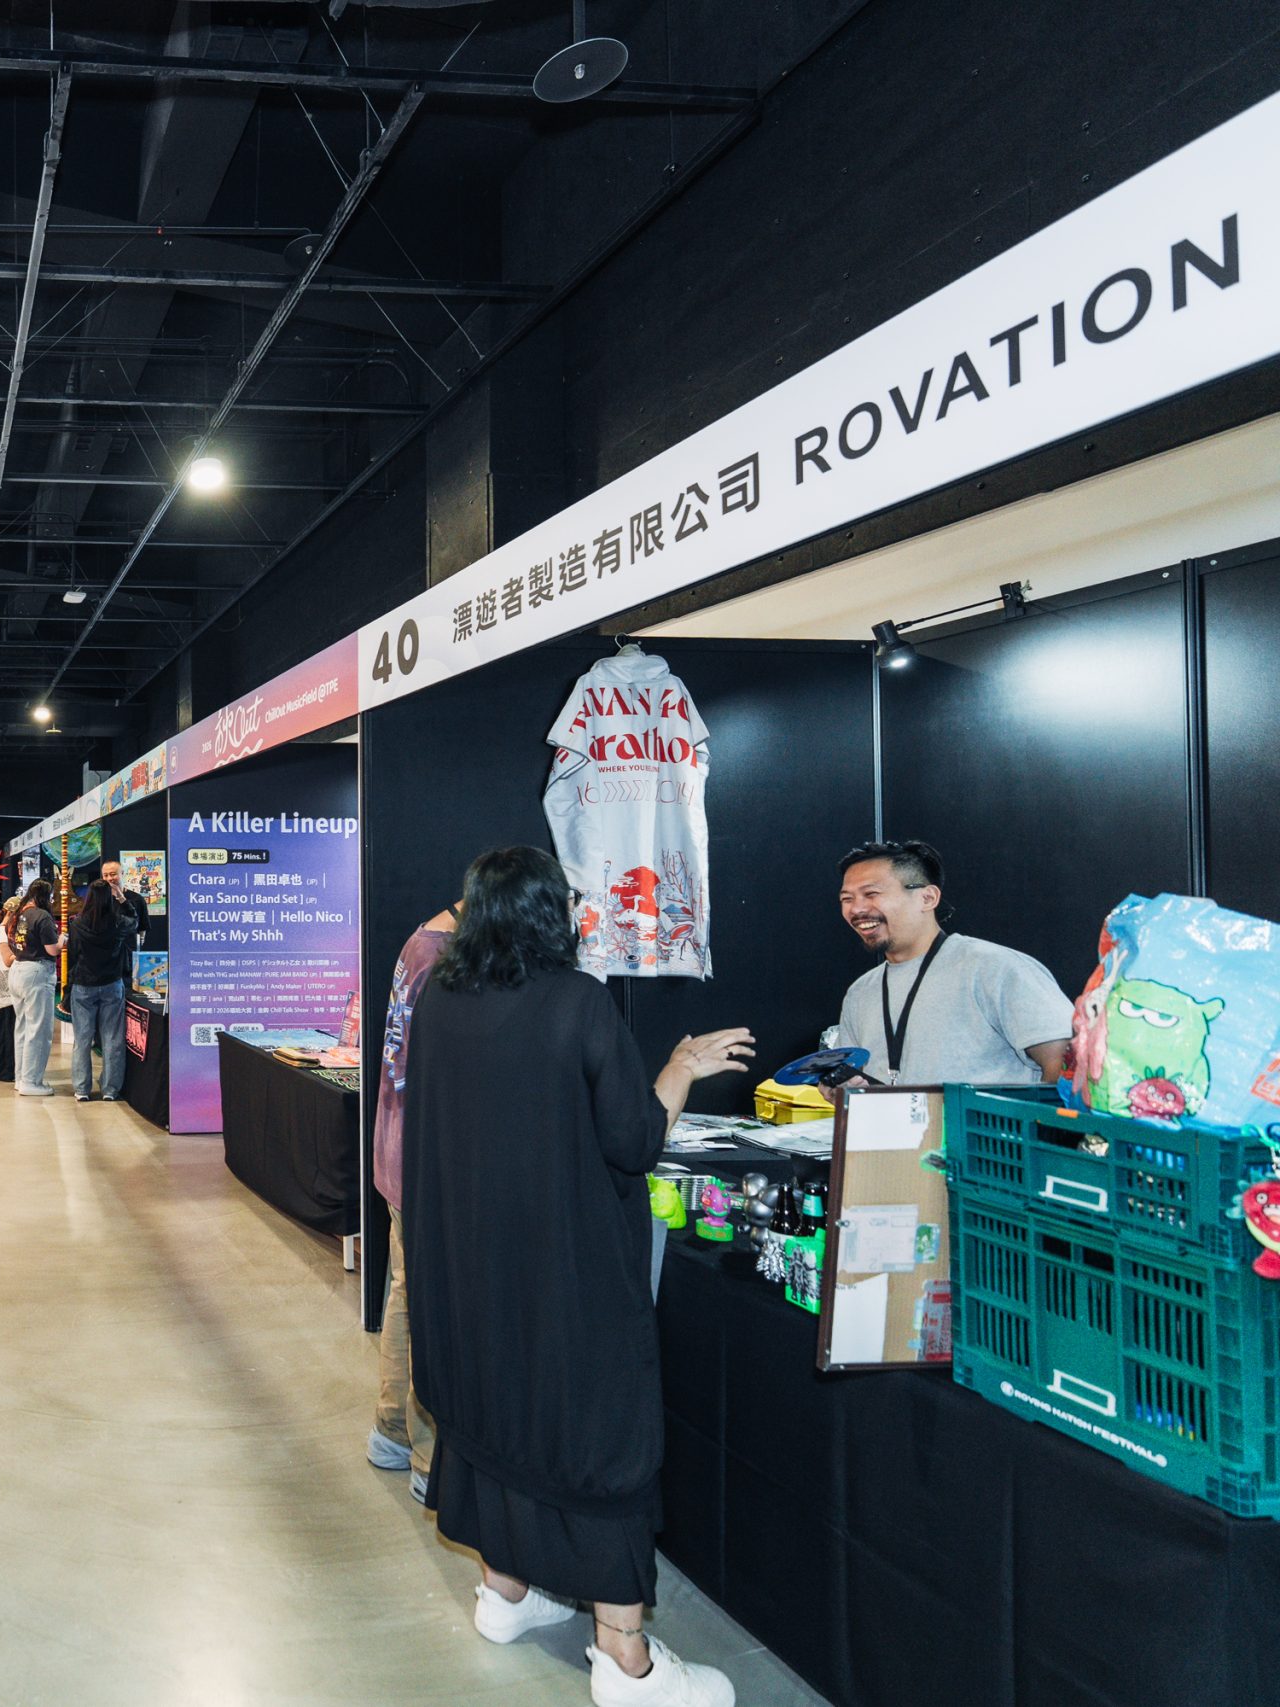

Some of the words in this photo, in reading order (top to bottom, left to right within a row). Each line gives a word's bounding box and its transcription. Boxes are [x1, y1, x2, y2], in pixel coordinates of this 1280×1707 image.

[794, 212, 1240, 486] ROVATION
[372, 618, 420, 685] 40
[452, 452, 761, 644] 漂遊者製造有限公司
[286, 687, 317, 713] MusicField
[318, 677, 339, 703] @TPE
[598, 765, 626, 773] WHERE
[188, 811, 205, 833] A
[212, 811, 274, 833] Killer
[281, 811, 358, 839] Lineup
[232, 852, 242, 860] 75
[189, 873, 225, 885] Chara
[189, 892, 213, 904] Kan
[217, 892, 248, 904] Sano
[256, 894, 280, 904] Band
[282, 894, 297, 904] Set
[281, 911, 313, 923] Hello
[316, 911, 344, 923] Nico
[189, 929, 226, 941] That's
[230, 930, 248, 943] My
[252, 929, 283, 941] Shhh
[1014, 1389, 1052, 1413] ROVING
[1052, 1407, 1092, 1432] NATION
[1092, 1425, 1157, 1463] FESTIVAL
